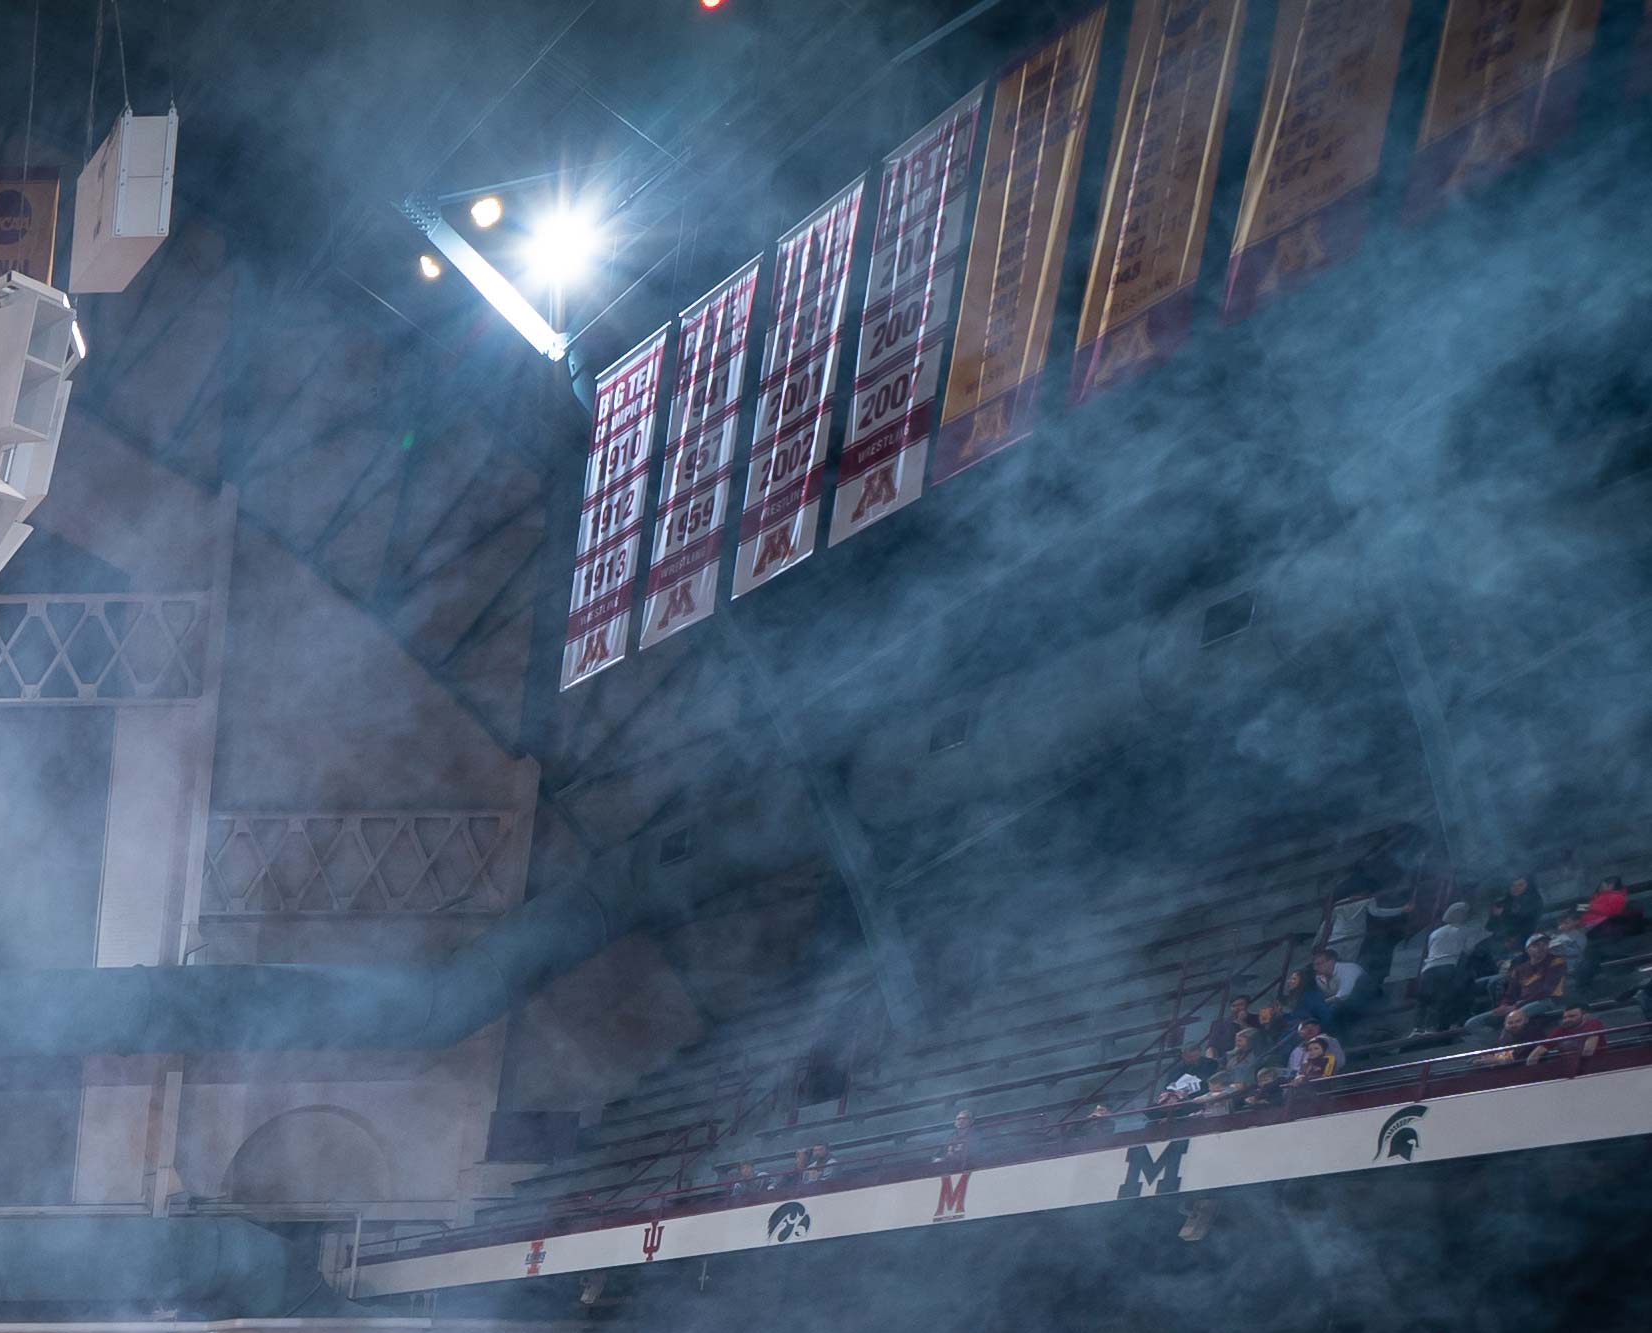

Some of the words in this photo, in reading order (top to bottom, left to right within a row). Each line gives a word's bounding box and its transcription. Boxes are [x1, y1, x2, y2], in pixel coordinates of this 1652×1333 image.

[597, 431, 642, 482] 1910
[759, 431, 816, 492] 2002
[591, 489, 634, 541] 1912
[666, 498, 715, 548] 1959
[584, 549, 626, 597] 1913
